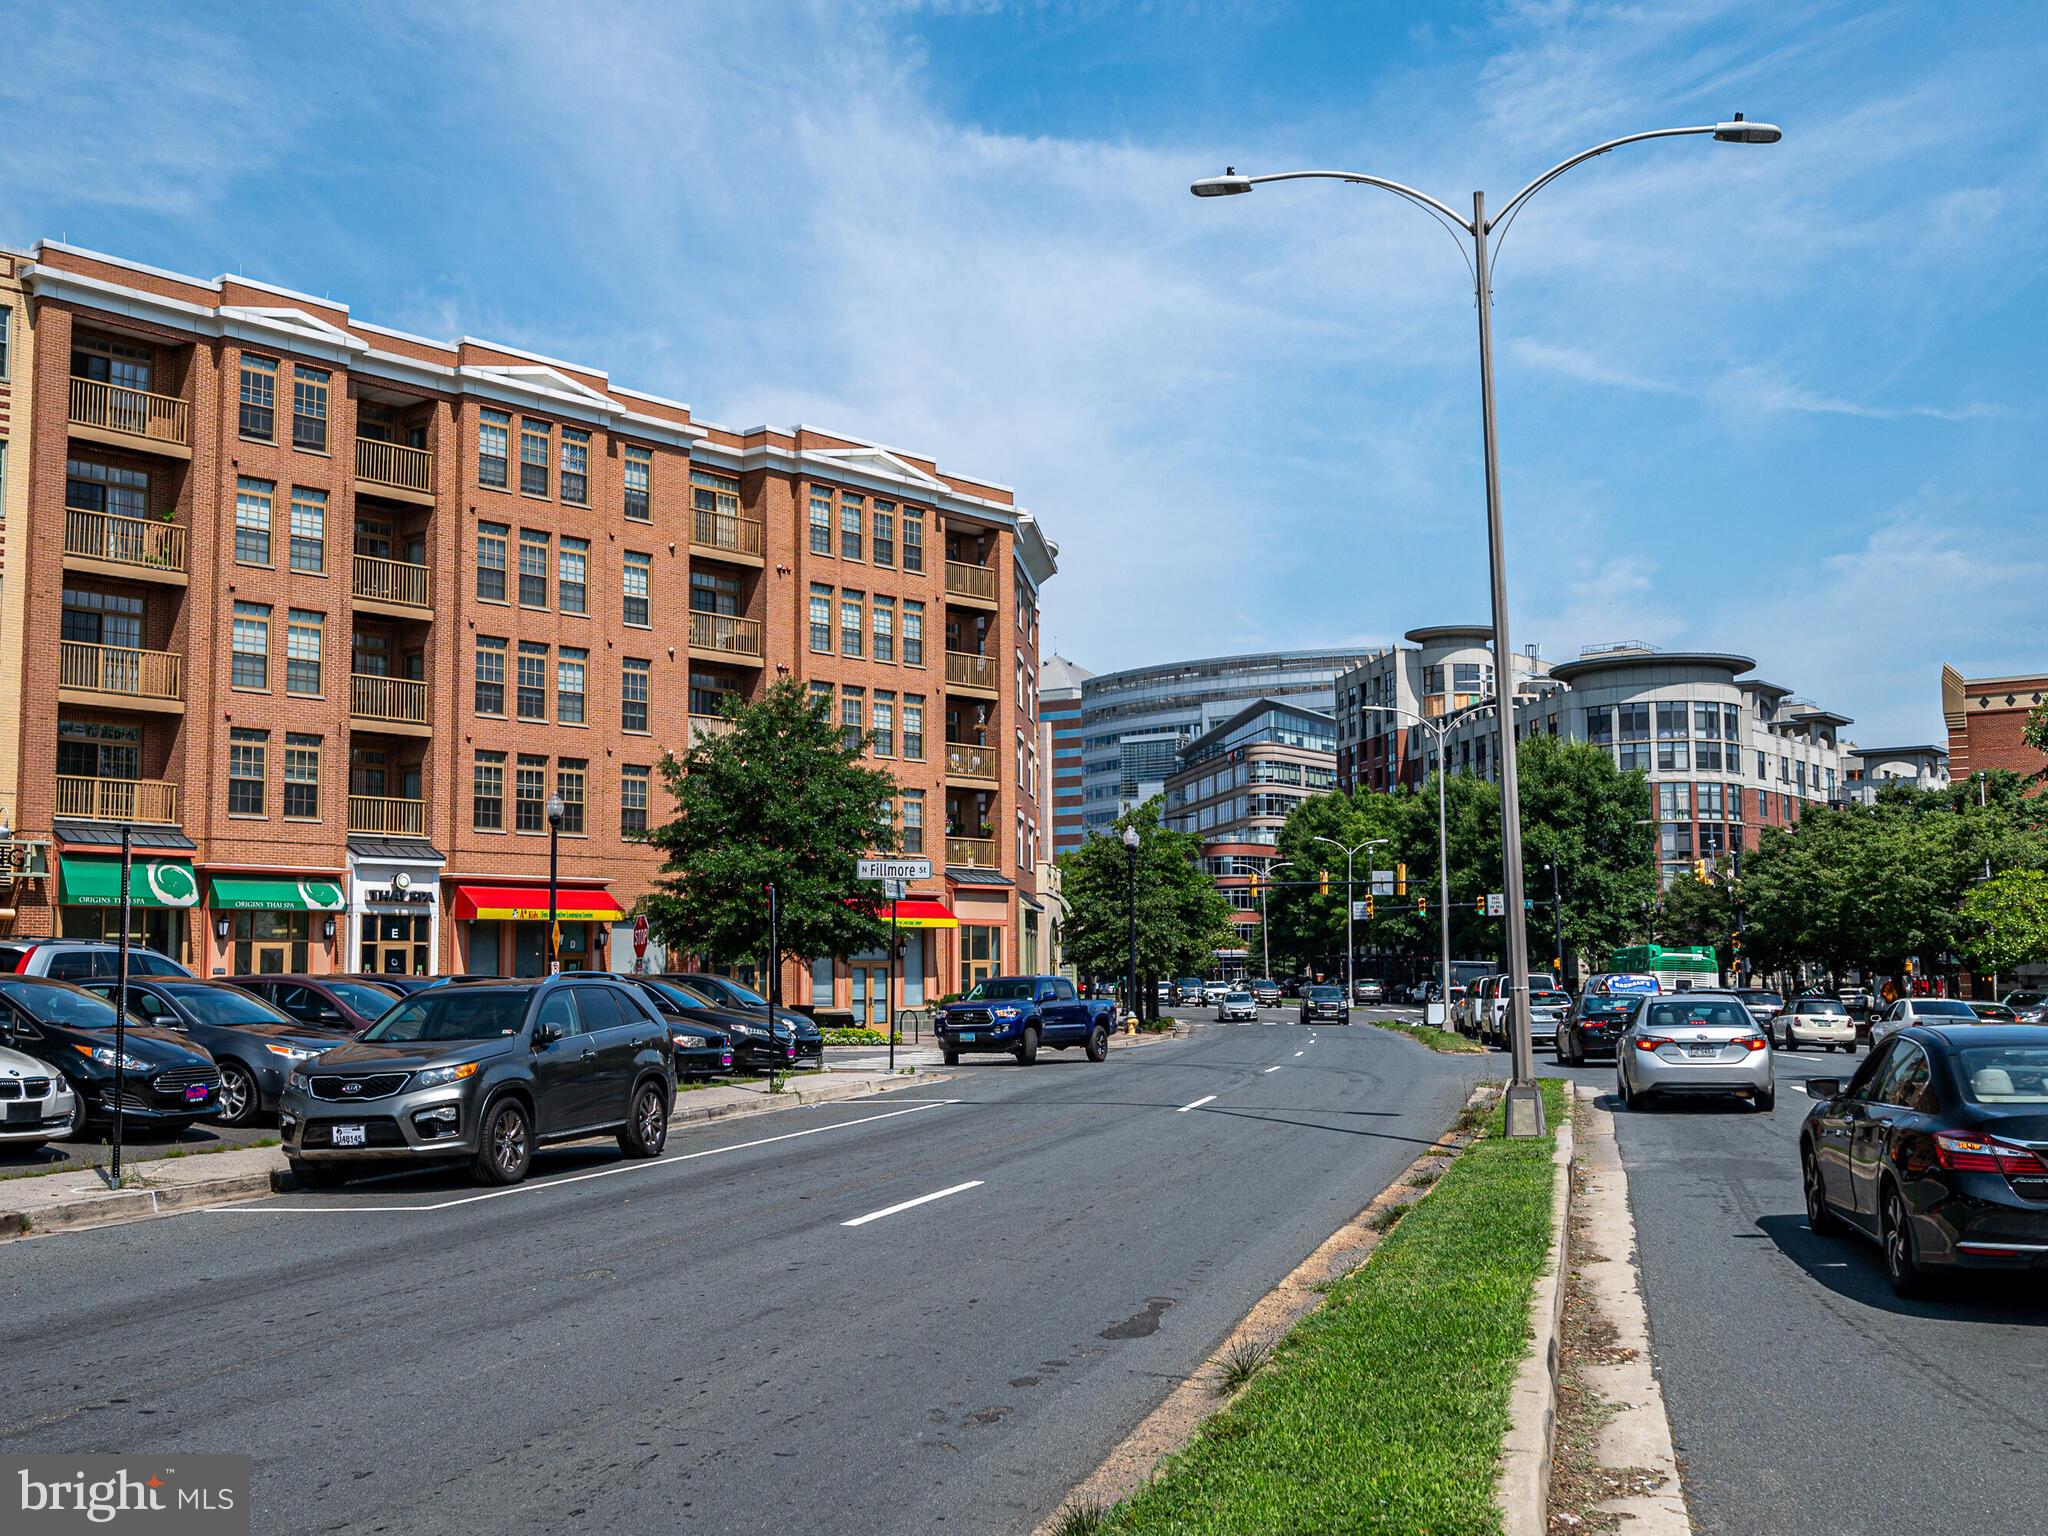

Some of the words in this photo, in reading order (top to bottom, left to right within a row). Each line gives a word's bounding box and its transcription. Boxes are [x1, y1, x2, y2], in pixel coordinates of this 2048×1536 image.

[870, 863, 915, 876] Fillmore
[78, 896, 111, 904] ORIGINS
[528, 910, 538, 919] Kids
[391, 928, 399, 938] E
[634, 928, 648, 946] STOP
[570, 940, 576, 949] D
